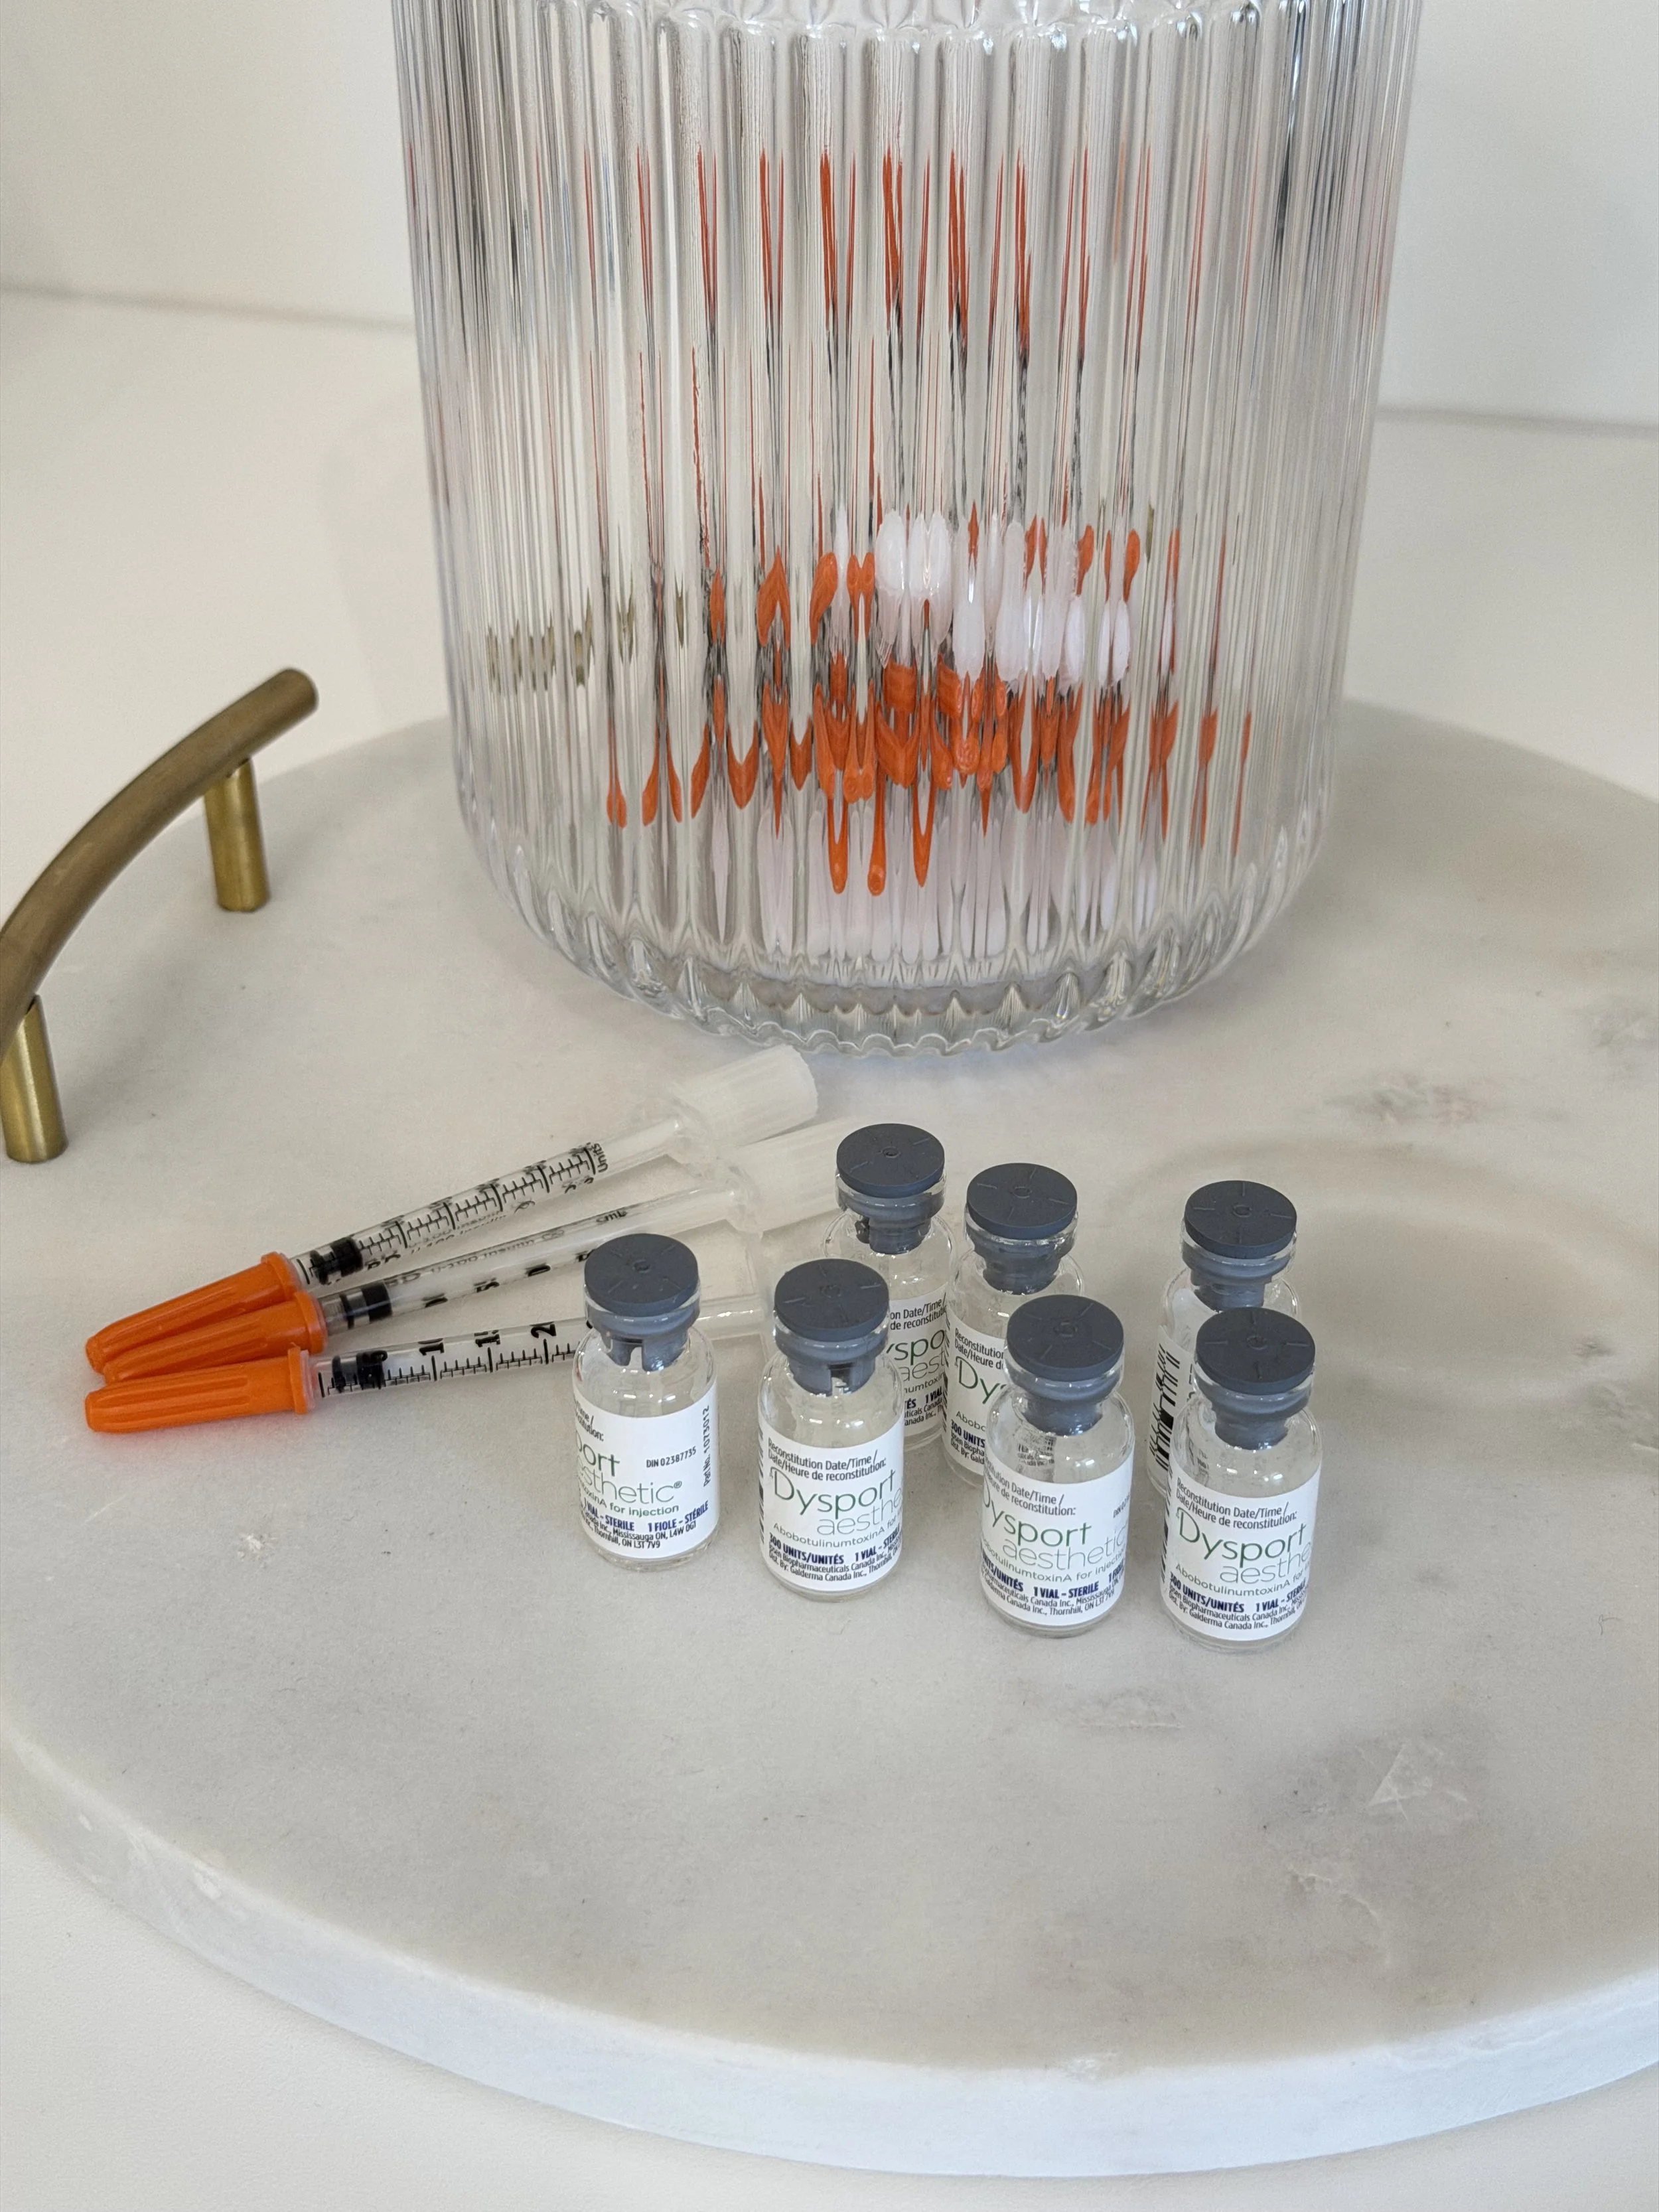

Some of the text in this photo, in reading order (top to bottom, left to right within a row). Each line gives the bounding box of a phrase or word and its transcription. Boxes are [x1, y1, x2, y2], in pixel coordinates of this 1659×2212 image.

[591, 1143, 609, 1173] Units
[890, 1321, 901, 1330] de
[955, 1338, 1003, 1370] Date/Heure d
[925, 1394, 929, 1404] 1
[646, 1446, 696, 1468] DIN 02387735
[768, 1437, 823, 1470] Reconstitution
[768, 1448, 887, 1481] Date/Heure de reconstitution:
[770, 1467, 896, 1519] Dysport
[1001, 1488, 1010, 1501] de
[1011, 1495, 1076, 1516] reconstitution:
[1177, 1477, 1231, 1516] Reconstitution
[605, 1514, 635, 1532] STERILE
[648, 1522, 652, 1532] 1
[654, 1518, 678, 1532] FIOLE
[684, 1500, 709, 1524] STÉRILE
[610, 1503, 625, 1513] for
[1176, 1488, 1297, 1529] Date/Heure de reconstitution:
[613, 1527, 654, 1542] Mississauga
[670, 1526, 684, 1538] L4W
[622, 1538, 632, 1548] ON
[634, 1540, 645, 1549] L3T
[648, 1540, 660, 1550] 7V9
[773, 1522, 885, 1548] AbobotulinumtoxinA
[1176, 1507, 1307, 1568] Dysport
[769, 1532, 782, 1550] 300
[782, 1542, 845, 1565] UNITS/UNITÉS
[855, 1552, 859, 1562] 1
[861, 1546, 877, 1560] VIAL
[782, 1552, 849, 1574] Biopharmaceuticals
[851, 1557, 875, 1571] Canada
[790, 1566, 824, 1581] Galderma
[825, 1572, 852, 1582] Canada
[1076, 1570, 1092, 1581] for
[1033, 1586, 1038, 1597] 1
[1040, 1587, 1060, 1599] VIAL
[1068, 1580, 1100, 1599] STERILE
[1170, 1571, 1181, 1590] 300
[1183, 1583, 1245, 1613] UNITS/UNITÉS
[1256, 1602, 1260, 1612] 1
[1262, 1598, 1279, 1611] VIAL
[1175, 1563, 1290, 1596] AbobotulinumtoxinA
[1007, 1595, 1031, 1612] Canada
[1049, 1605, 1083, 1615] Thornhill,
[1084, 1601, 1094, 1611] ON
[1031, 1596, 1058, 1607] Canada
[1183, 1595, 1250, 1622] Biopharmaceuticals
[1252, 1609, 1277, 1621] Canada
[1189, 1608, 1222, 1628] Galderma
[1224, 1621, 1252, 1630] Canada
